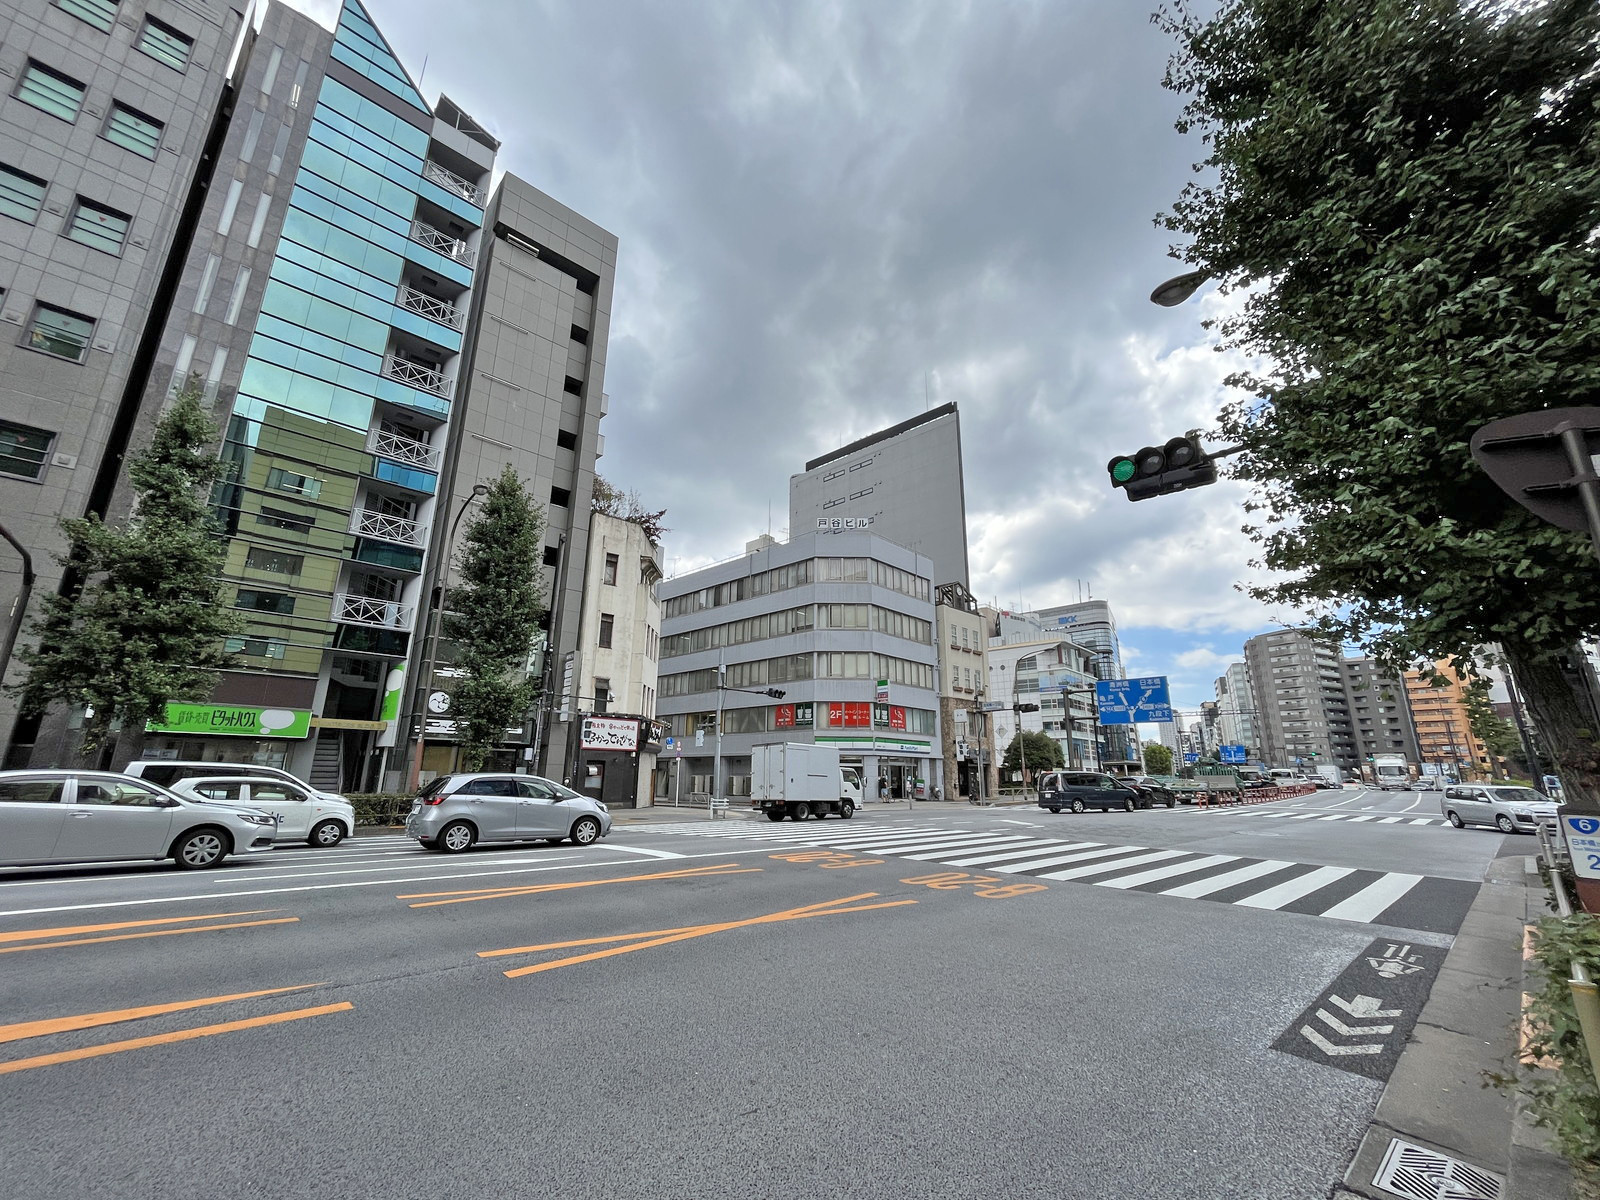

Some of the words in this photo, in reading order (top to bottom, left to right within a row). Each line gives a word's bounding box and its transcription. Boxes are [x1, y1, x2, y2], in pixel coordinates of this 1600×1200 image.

[818, 518, 867, 528] 戸谷ビル
[211, 710, 256, 727] ピタットハウス
[830, 710, 842, 718] 2F
[1579, 819, 1592, 830] 6
[899, 872, 1049, 899] 8-20
